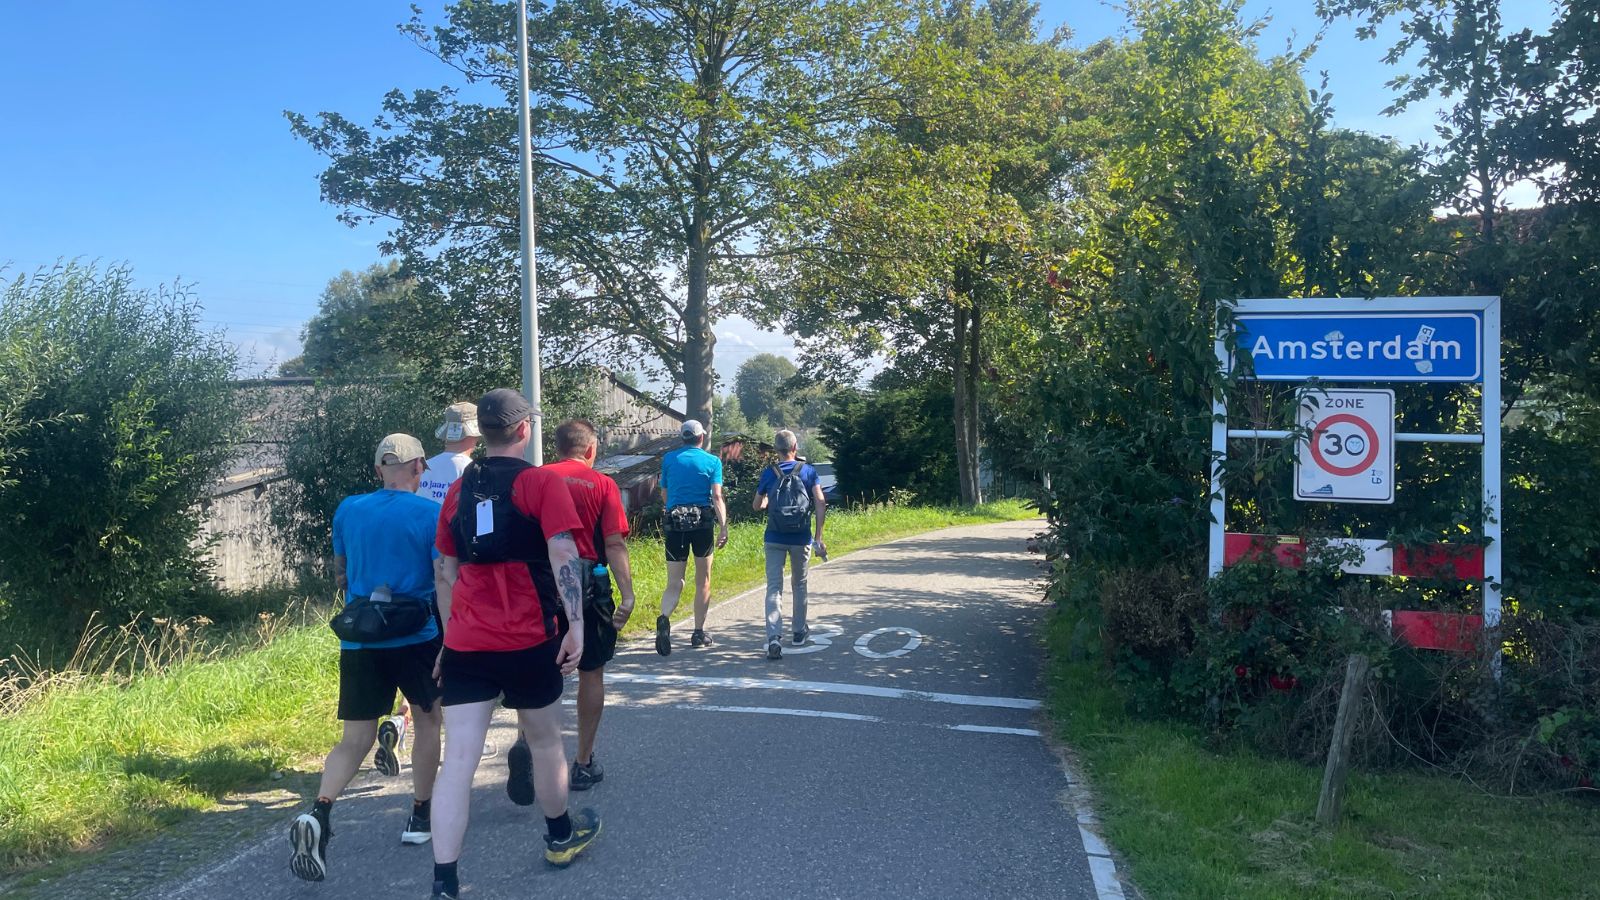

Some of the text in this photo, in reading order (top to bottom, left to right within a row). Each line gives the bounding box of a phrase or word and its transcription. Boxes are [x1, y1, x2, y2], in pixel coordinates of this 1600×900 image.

[1251, 335, 1461, 360] Amsterdam
[1325, 398, 1364, 409] ZONE
[1324, 433, 1365, 456] 30
[428, 480, 446, 490] jaar
[763, 624, 922, 659] 30
